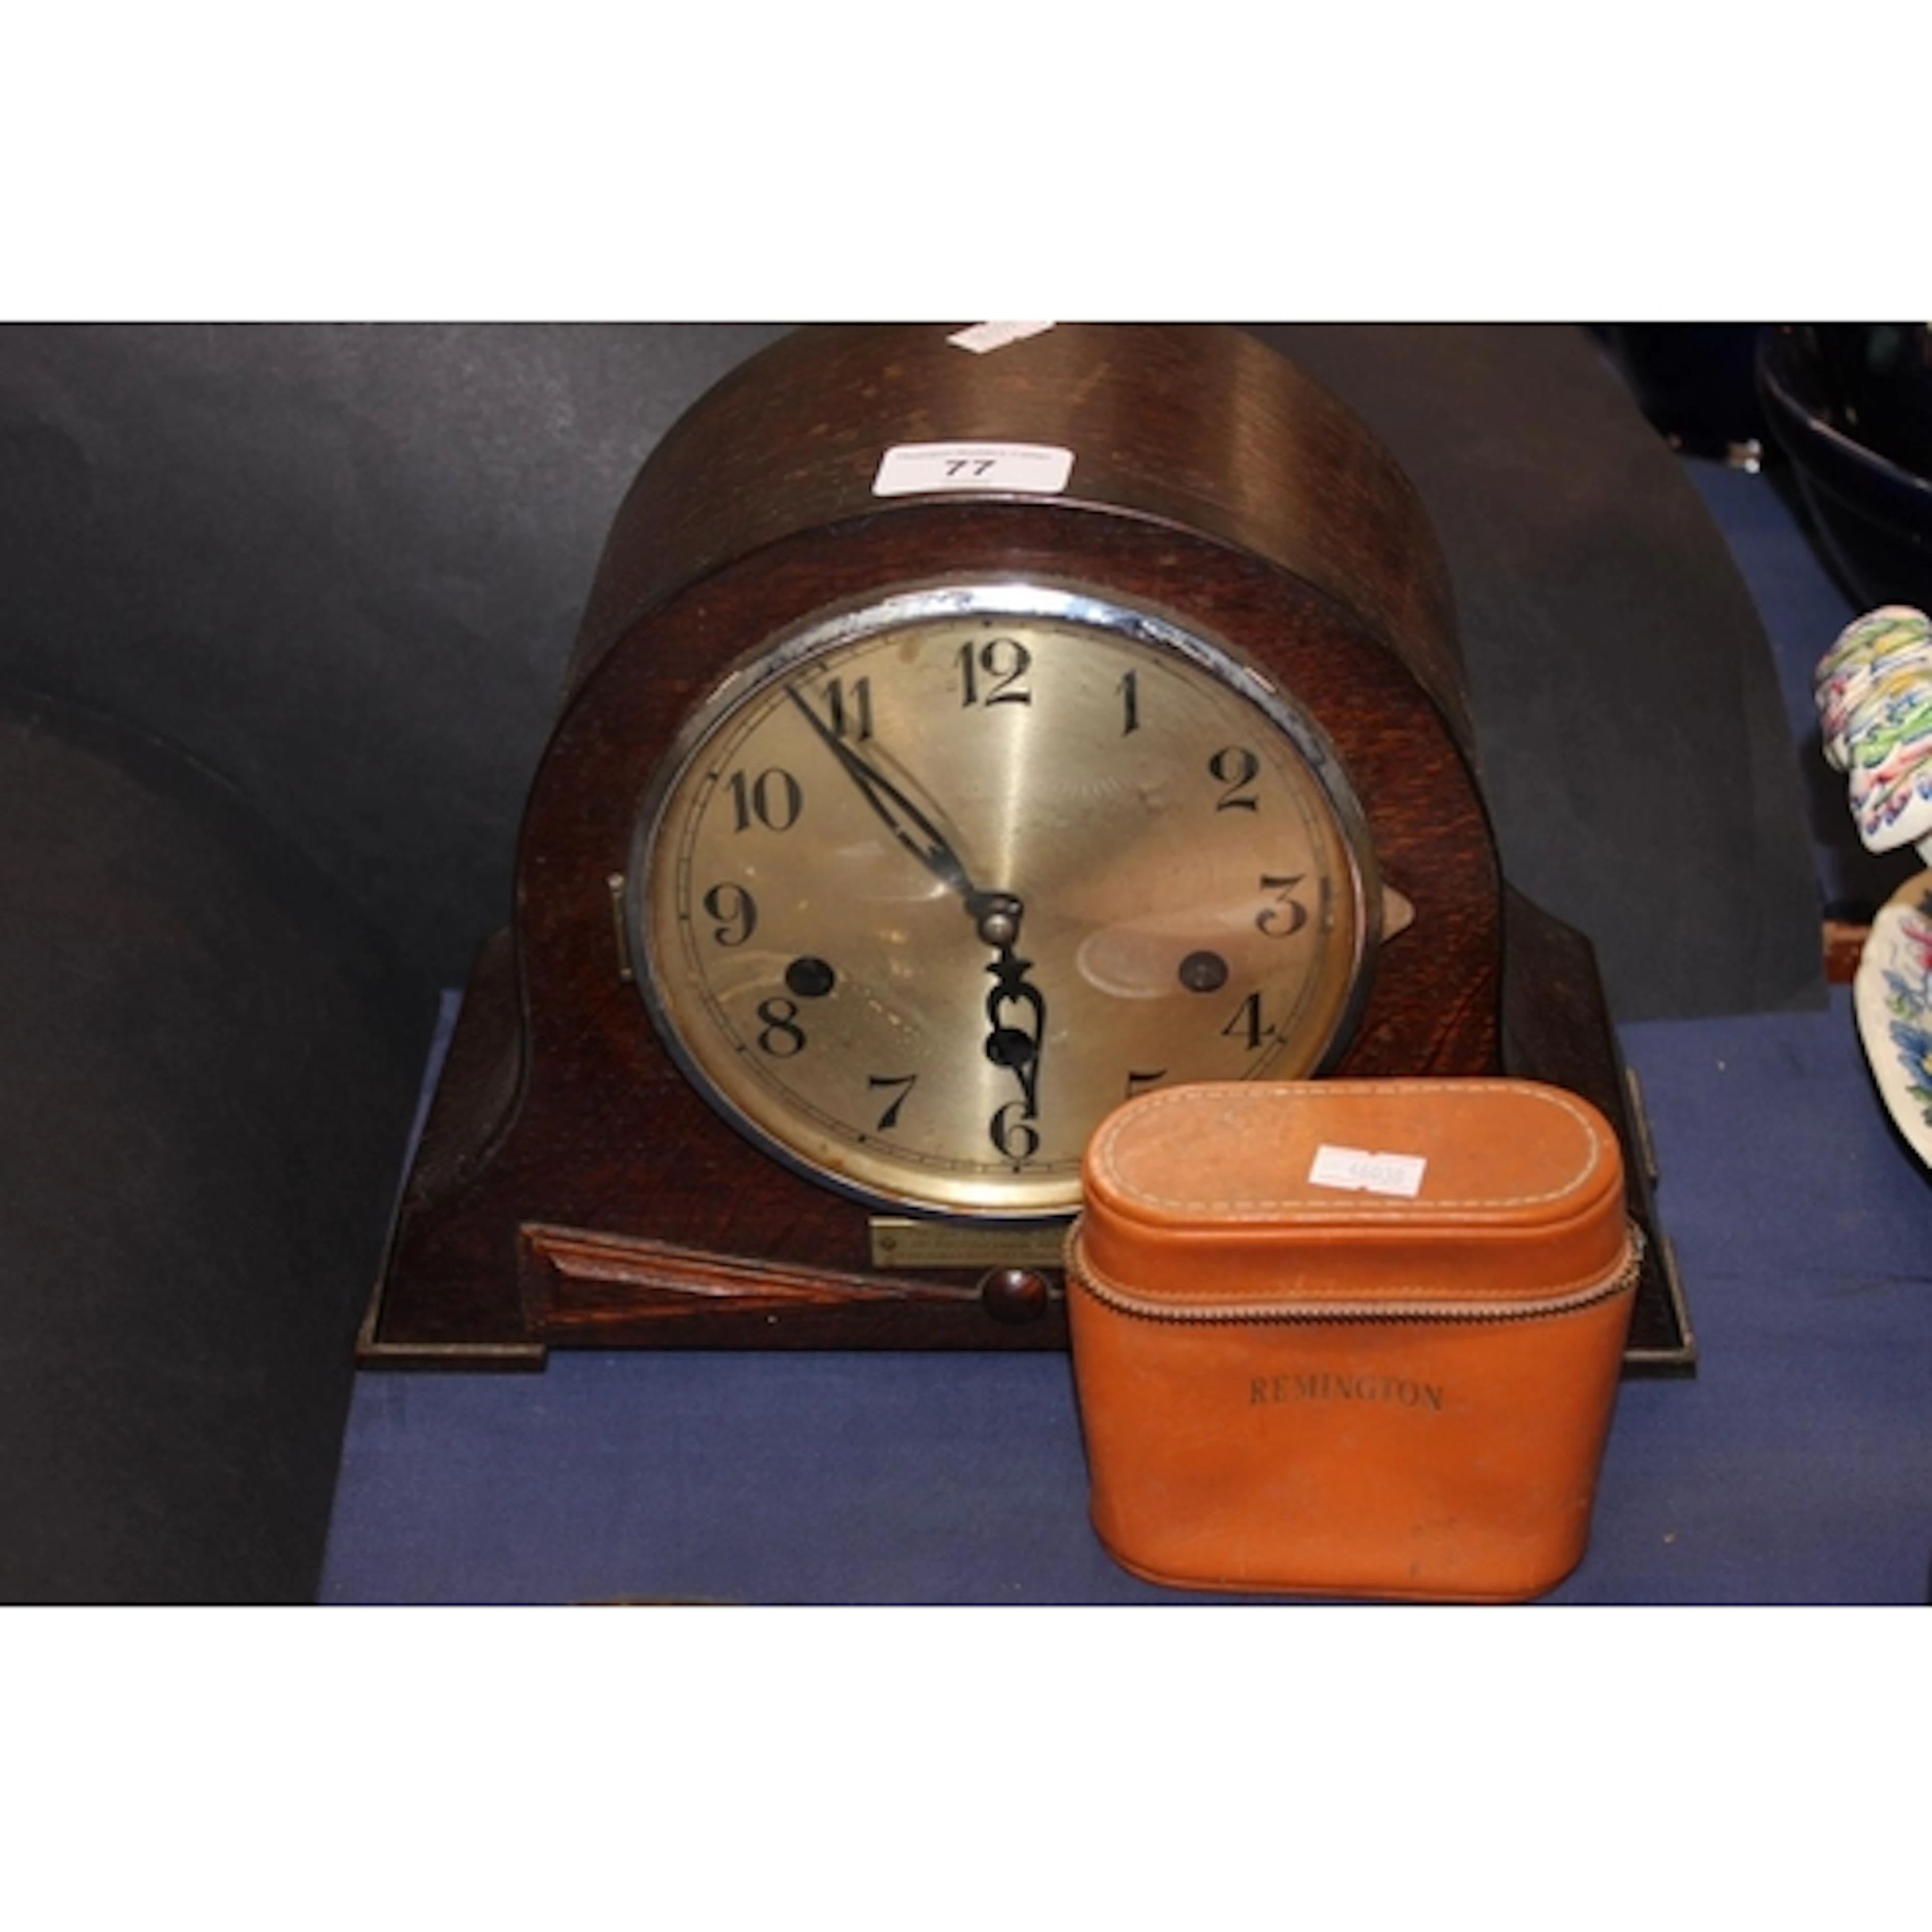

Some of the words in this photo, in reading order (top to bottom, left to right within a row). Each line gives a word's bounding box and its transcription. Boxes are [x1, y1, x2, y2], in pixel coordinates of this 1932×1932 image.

[945, 459, 996, 475] 77
[955, 637, 1032, 708] 12
[1115, 668, 1141, 738] 1
[821, 676, 873, 742] 11
[726, 767, 802, 834] 10
[1210, 746, 1260, 813] 2
[704, 881, 758, 947] 9
[1255, 873, 1308, 939] 3
[756, 997, 807, 1059] 8
[1221, 990, 1276, 1052] 4
[868, 1073, 918, 1132] 7
[990, 1101, 1040, 1160] 6
[1250, 1372, 1443, 1411] REMINGTON
